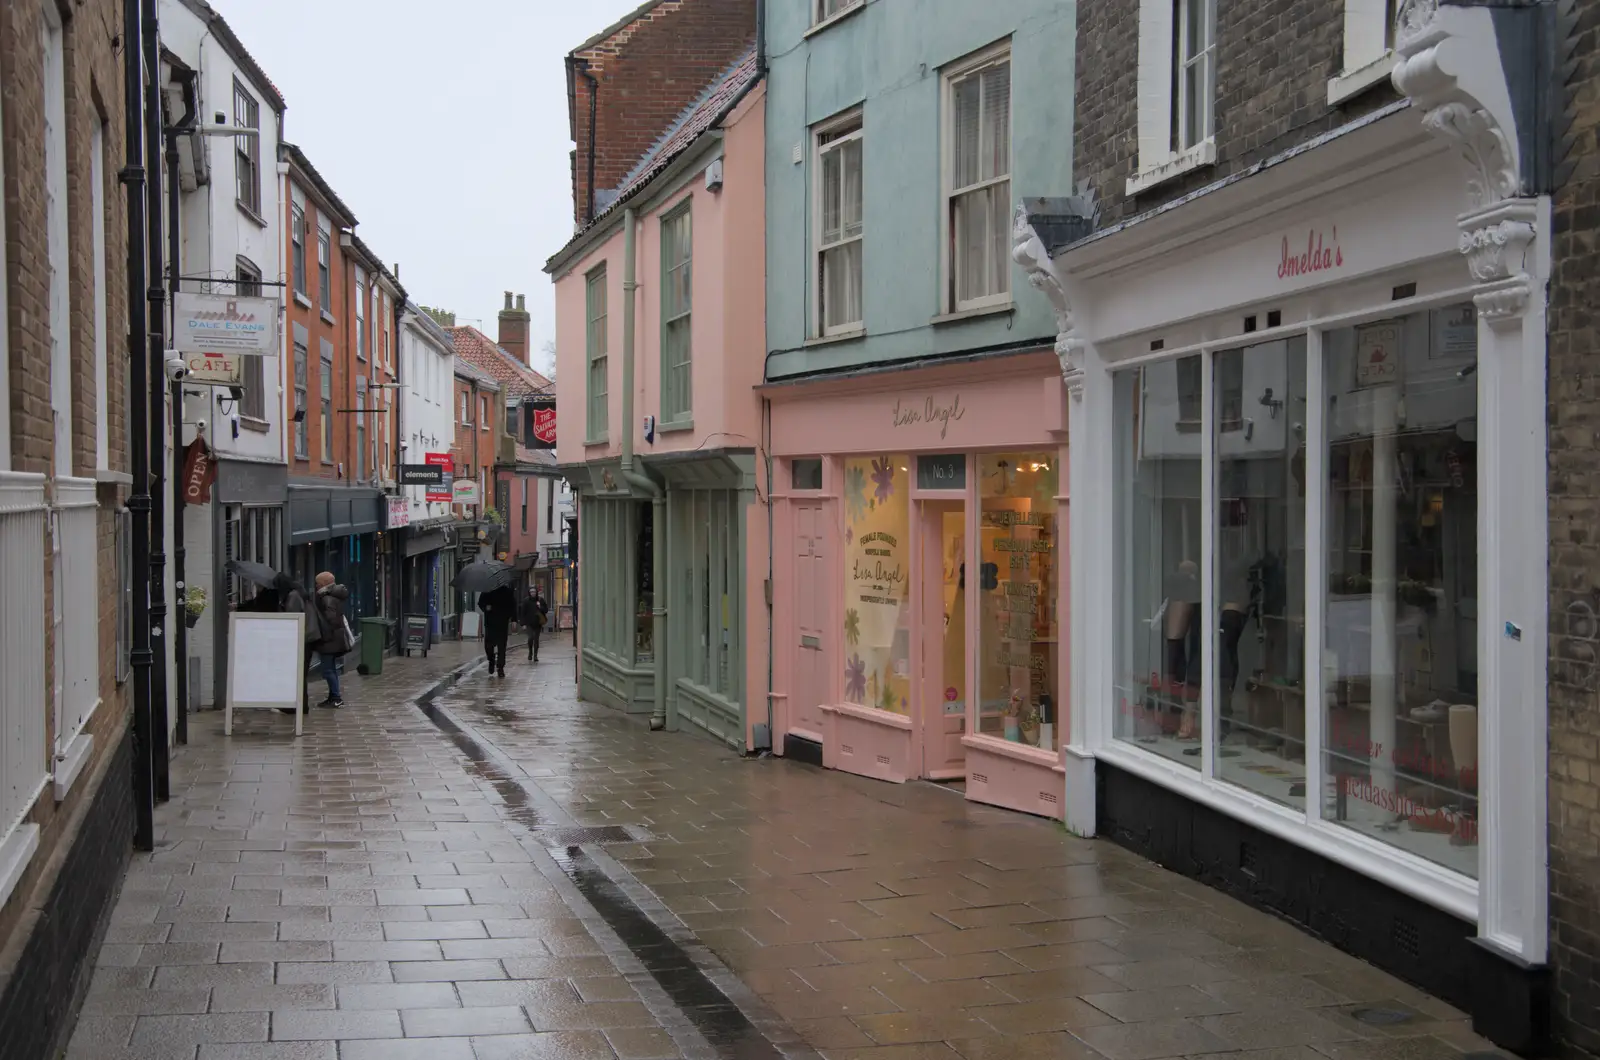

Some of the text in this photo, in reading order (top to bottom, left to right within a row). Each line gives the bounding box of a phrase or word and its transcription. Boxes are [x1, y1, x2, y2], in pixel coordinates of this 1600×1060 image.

[1278, 225, 1343, 279] Imelda's
[189, 320, 265, 331] DALE EVANS
[190, 359, 234, 371] CAFE
[540, 412, 552, 422] THE
[893, 393, 966, 440] Lisa Angel
[188, 452, 208, 496] OPEN
[933, 464, 955, 479] No. 3
[860, 532, 877, 547] FEMALE
[853, 558, 906, 595] Lisa Angel
